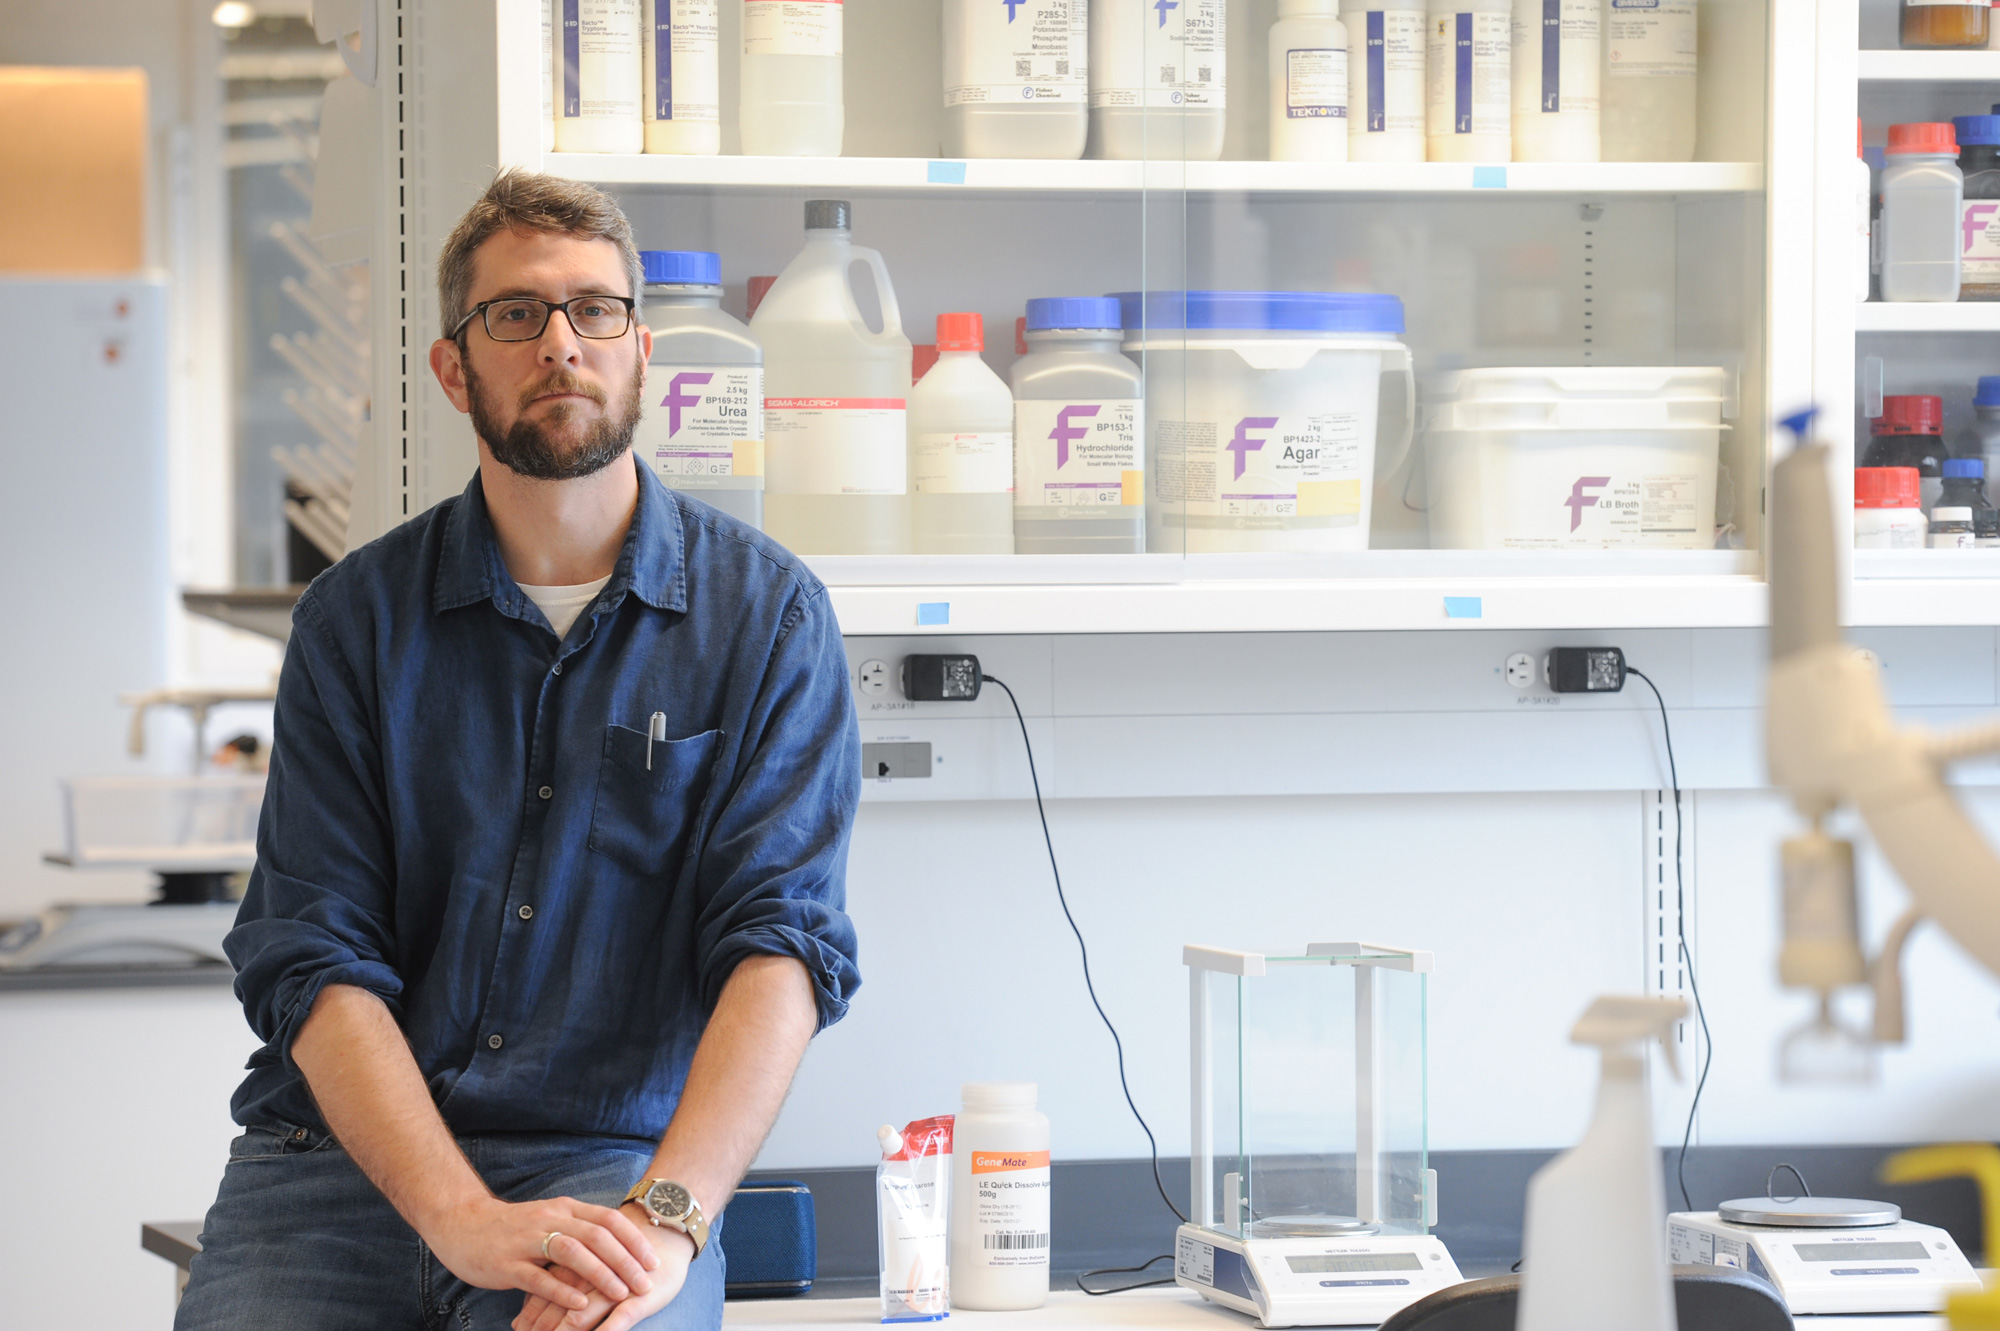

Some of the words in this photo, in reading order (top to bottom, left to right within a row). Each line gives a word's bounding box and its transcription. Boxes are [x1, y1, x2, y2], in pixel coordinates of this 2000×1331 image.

[1058, 1, 1067, 9] kg
[1038, 11, 1067, 19] P285-3
[1206, 10, 1214, 18] kg
[1186, 20, 1214, 28] S671-3
[726, 386, 738, 394] 2.5
[738, 386, 748, 395] kg
[706, 396, 748, 404] BP169-212
[718, 406, 748, 416] Urea
[1124, 414, 1134, 422] kg
[1096, 423, 1133, 432] BP153-1
[1283, 436, 1320, 444] BP1423-2
[1076, 444, 1134, 454] Hydrochloride
[1283, 446, 1320, 463] Agar
[710, 465, 718, 474] G
[1099, 493, 1107, 501] G
[1600, 500, 1612, 508] LB
[1615, 500, 1639, 508] Broth
[976, 1156, 1027, 1168] GeneMate
[990, 1181, 1012, 1189] Quick
[1014, 1181, 1040, 1189] Dissolve
[979, 1190, 996, 1199] 500g
